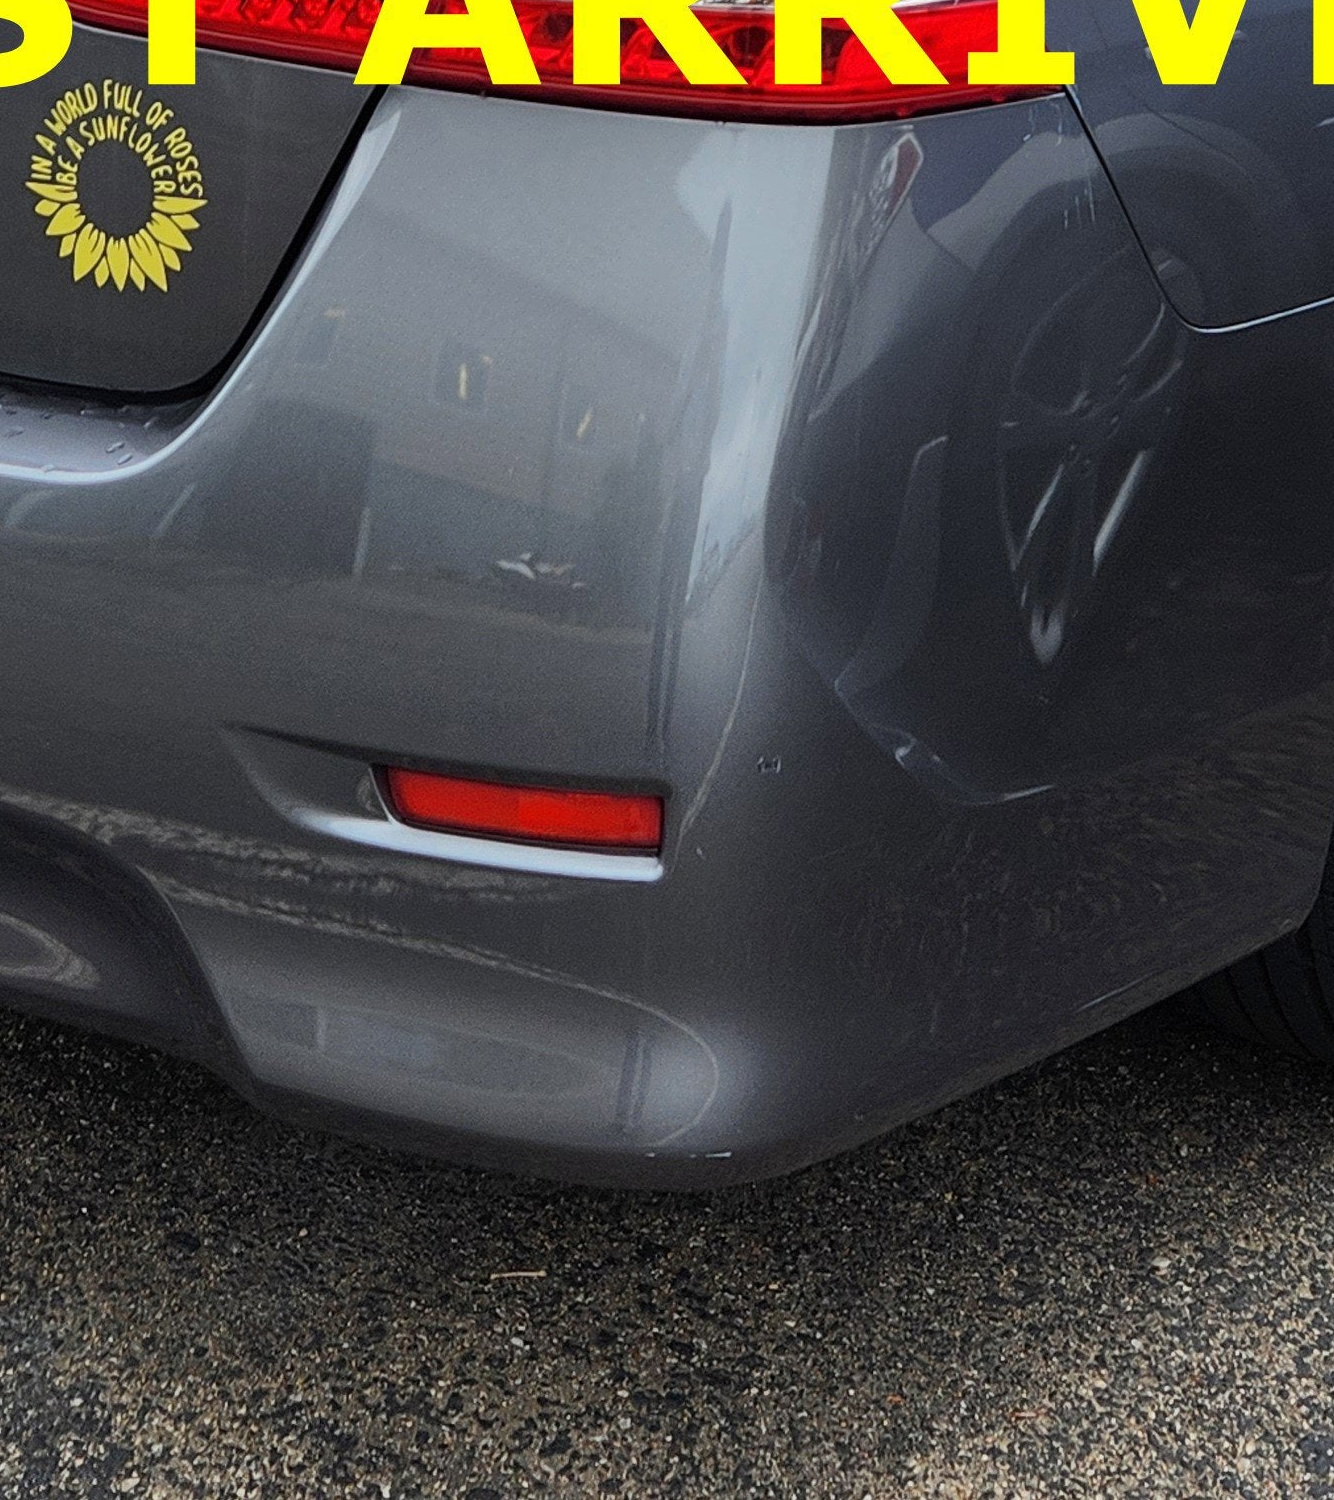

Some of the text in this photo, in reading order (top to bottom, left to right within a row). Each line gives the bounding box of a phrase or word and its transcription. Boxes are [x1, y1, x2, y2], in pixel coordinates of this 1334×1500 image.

[30, 79, 204, 198] IN A WORLD FULL OF ROSES
[55, 113, 177, 194] BE A SUNFLOWER
